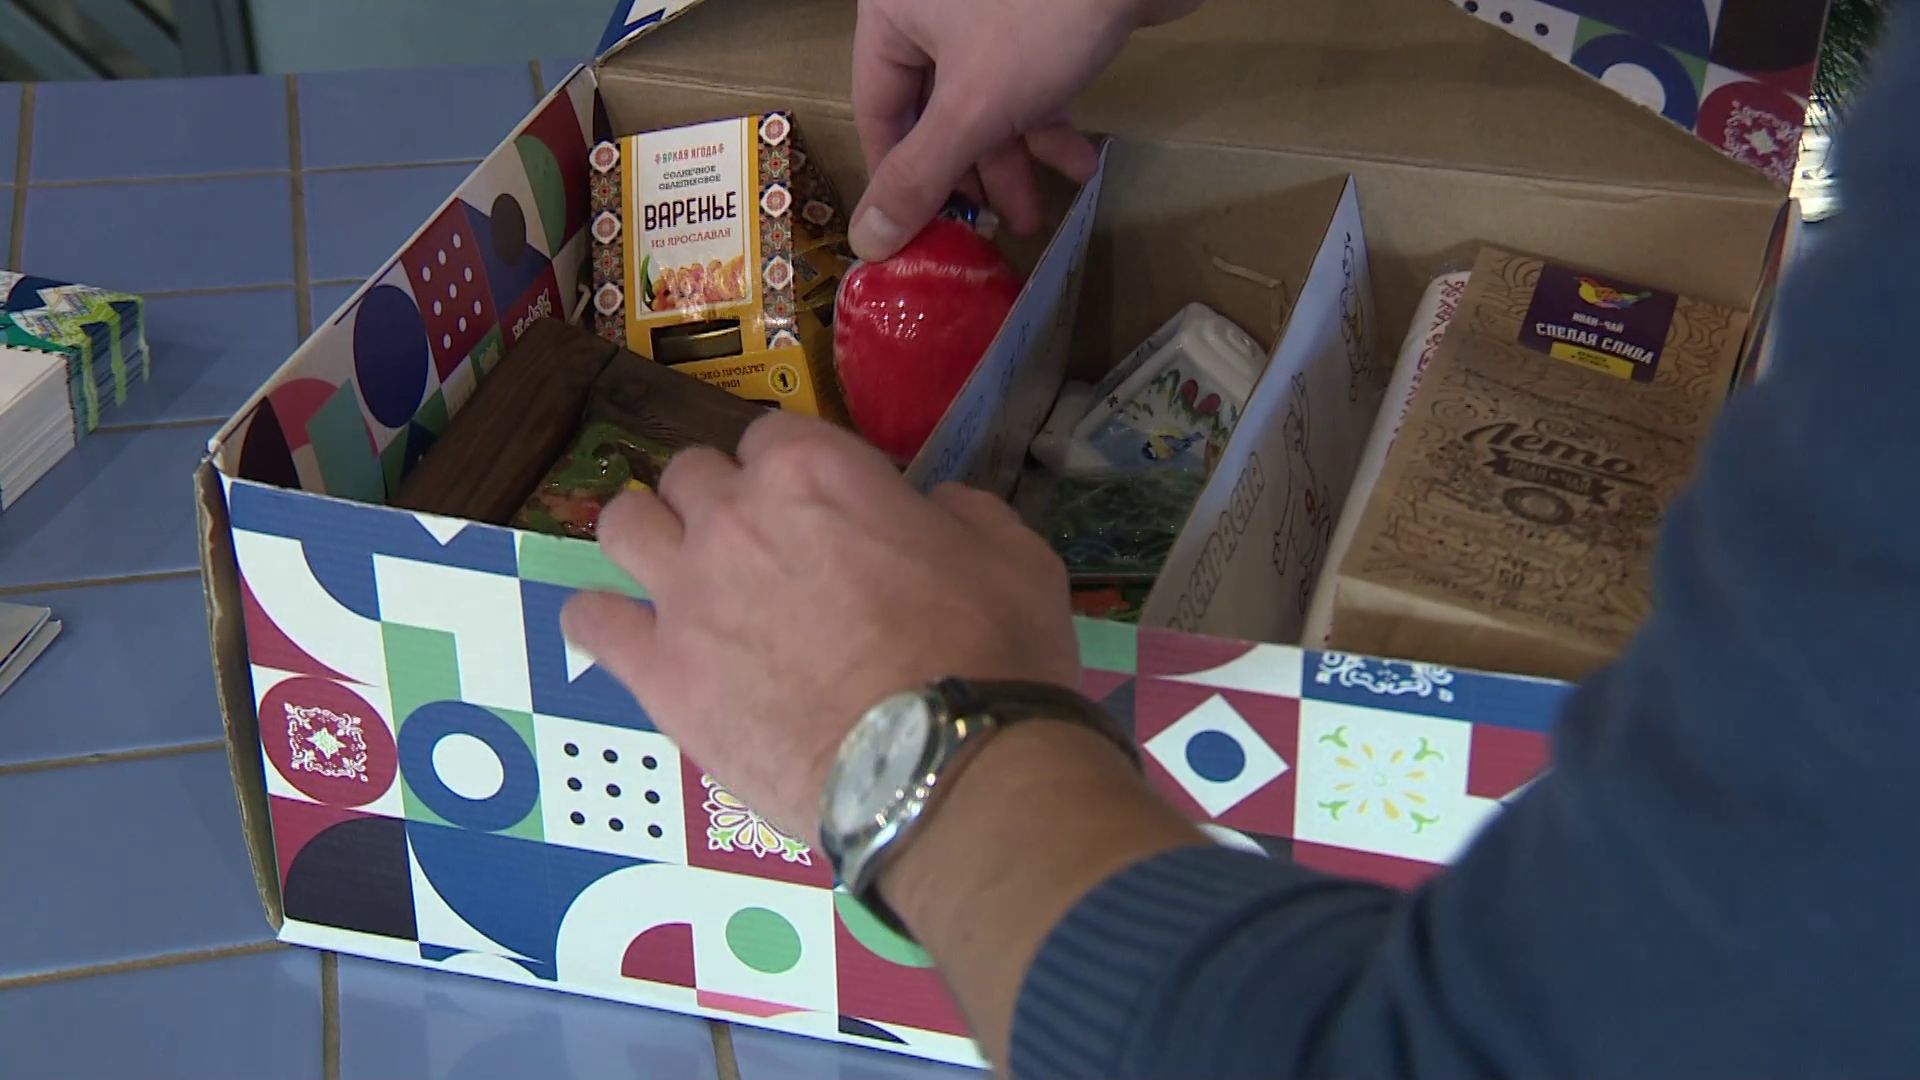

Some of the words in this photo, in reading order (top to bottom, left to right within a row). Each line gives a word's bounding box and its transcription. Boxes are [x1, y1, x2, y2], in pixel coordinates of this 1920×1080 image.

[662, 149, 689, 164] ЯРКАЯ
[691, 145, 718, 159] ЯГОДА
[663, 165, 716, 180] СОЛНЕЧНОЕ
[644, 191, 737, 231] ВАРЕНЬЕ
[651, 239, 666, 249] ИЗ
[667, 228, 731, 247] ЯРОСЛАВЛЯ
[1535, 322, 1599, 347] СПЕЛАЯ
[1601, 336, 1656, 365] СЛИВА
[722, 363, 766, 378] ПРОДУКТ
[1463, 421, 1637, 475] Лето
